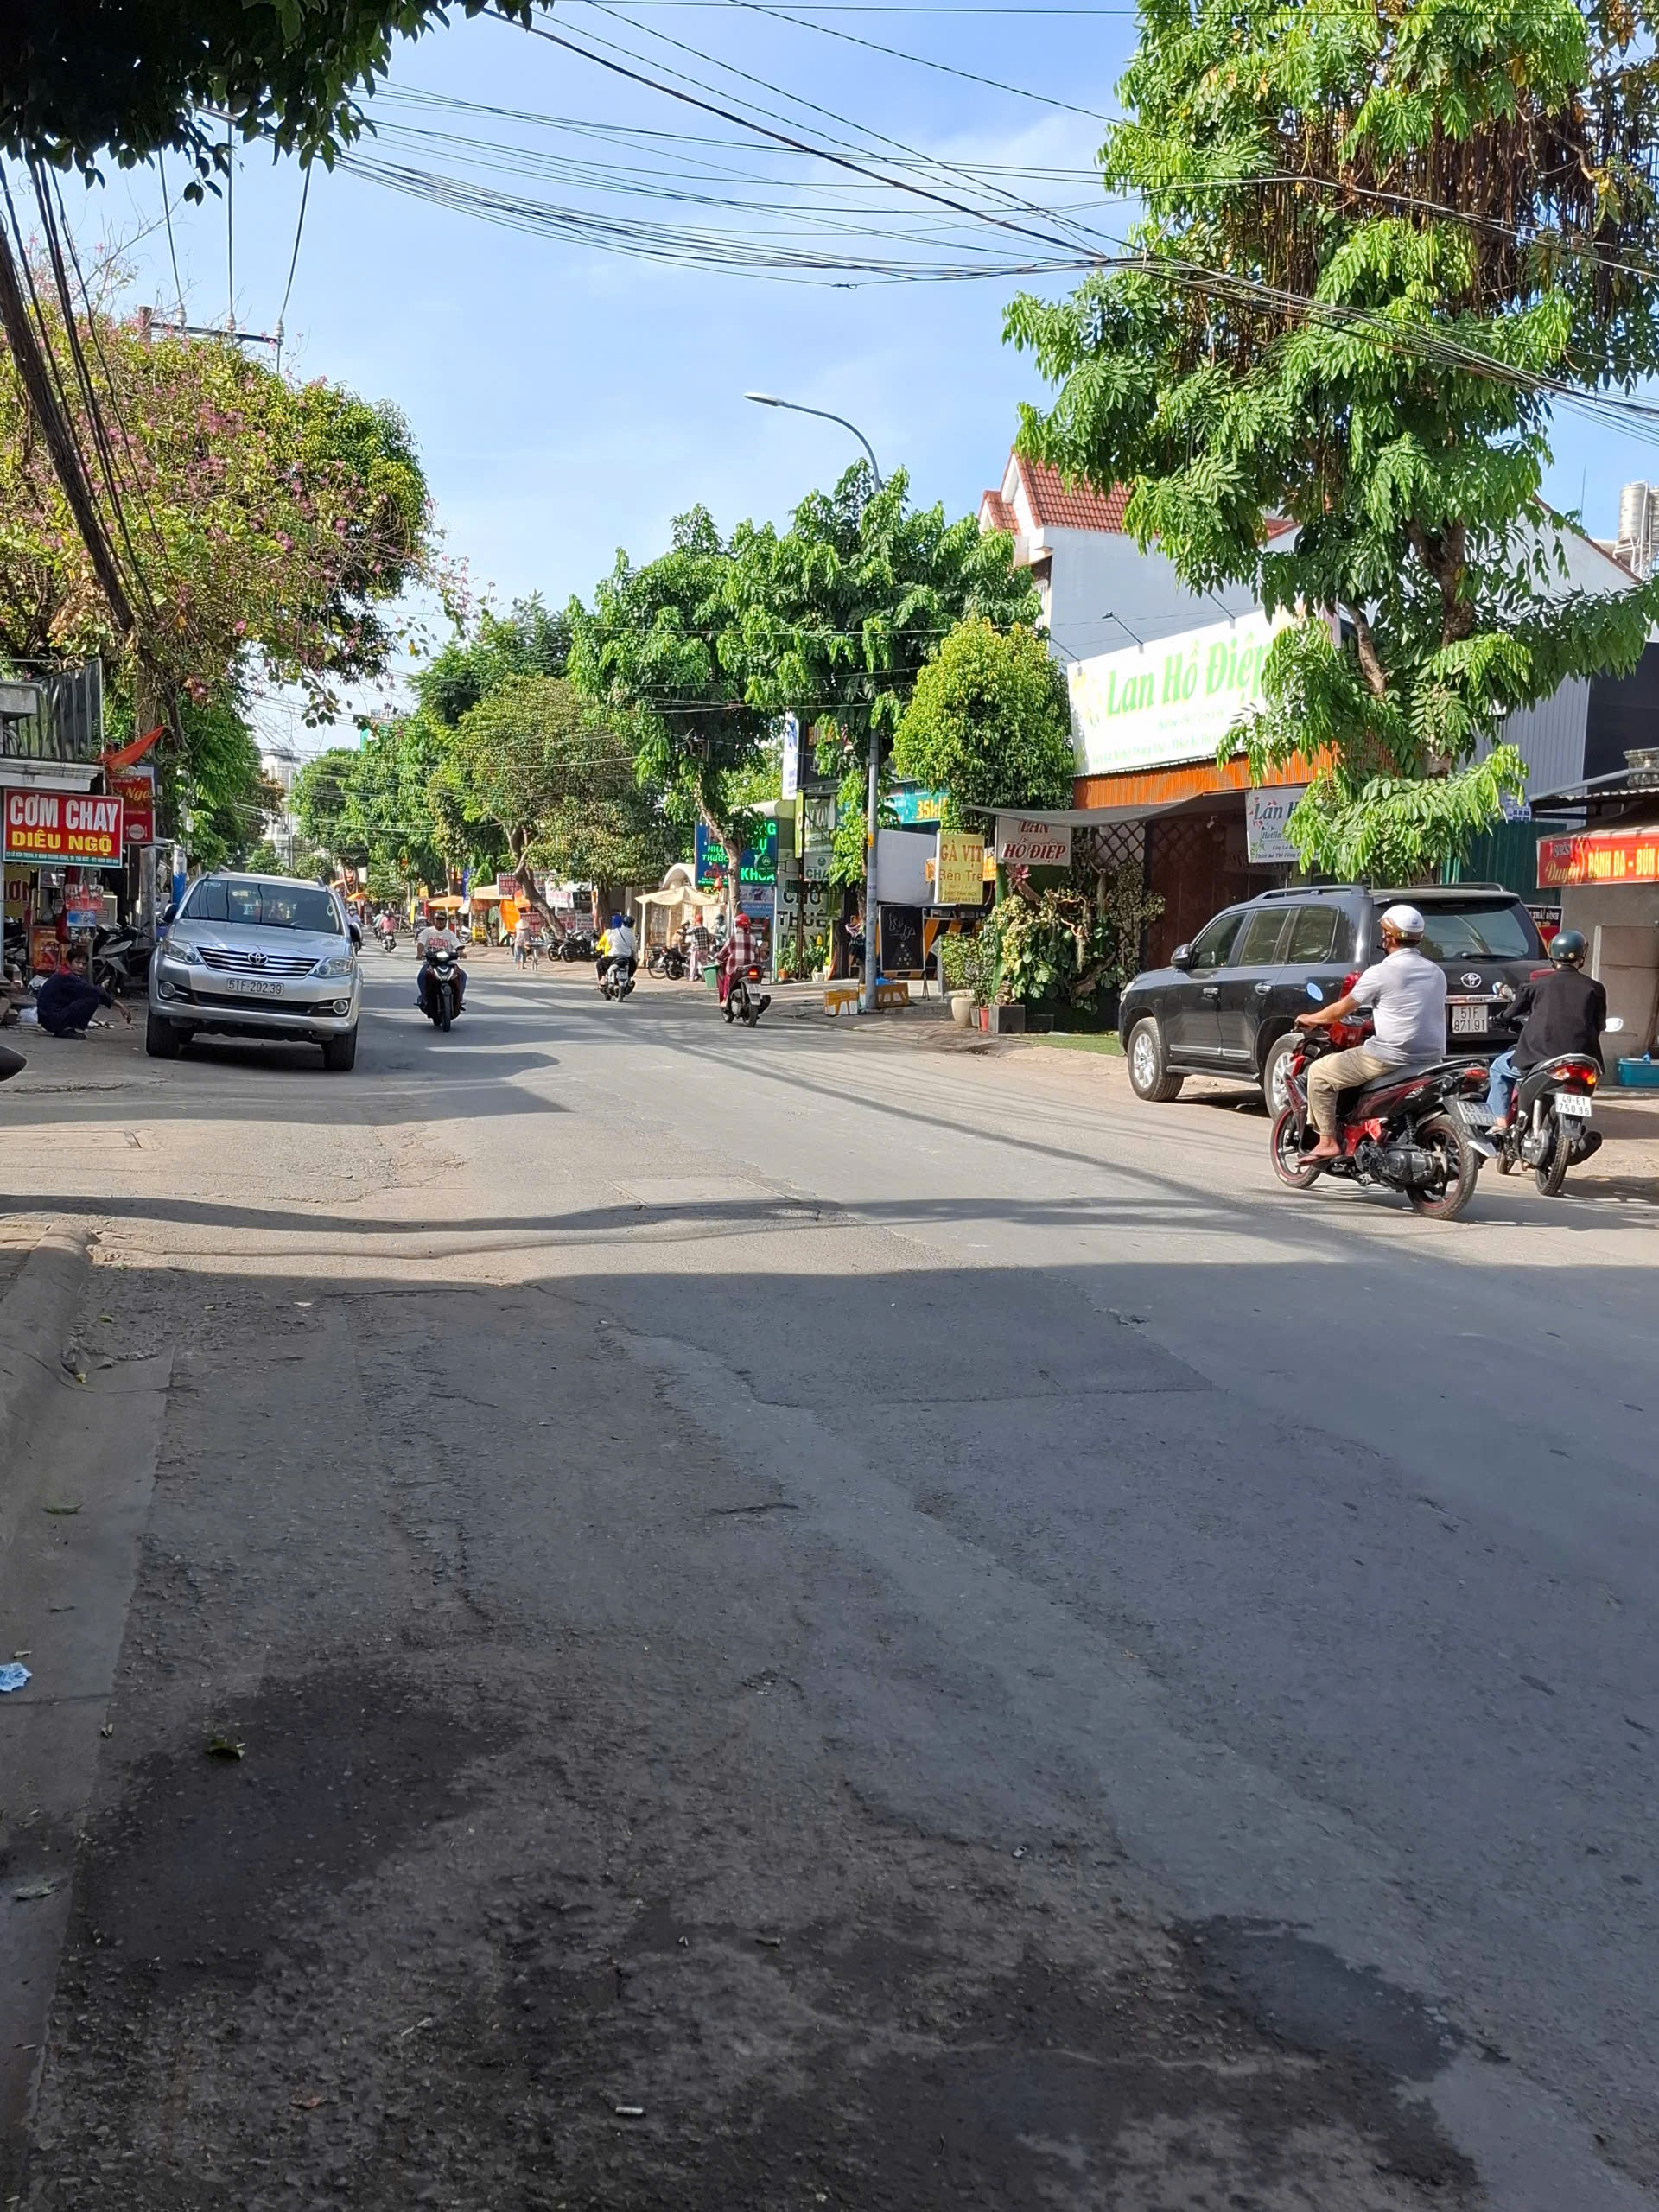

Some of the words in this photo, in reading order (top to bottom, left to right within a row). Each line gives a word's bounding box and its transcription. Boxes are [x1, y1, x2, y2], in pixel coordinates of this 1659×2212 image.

[1107, 669, 1154, 716] Lan
[1162, 638, 1198, 706] Hồ
[10, 794, 59, 829] CƠM
[66, 800, 119, 833] CHAY
[1254, 803, 1283, 820] Lan
[68, 835, 112, 855] NGỘ
[939, 840, 957, 861] GÀ
[962, 844, 983, 868] VỊT
[1003, 837, 1026, 858] HỒ
[1029, 841, 1066, 863] ĐIỆP
[1636, 843, 1656, 876] BÚN
[938, 867, 961, 881] Bến
[965, 869, 983, 882] Tre
[1460, 1007, 1478, 1019] 51F
[1454, 1020, 1485, 1032] 871.91
